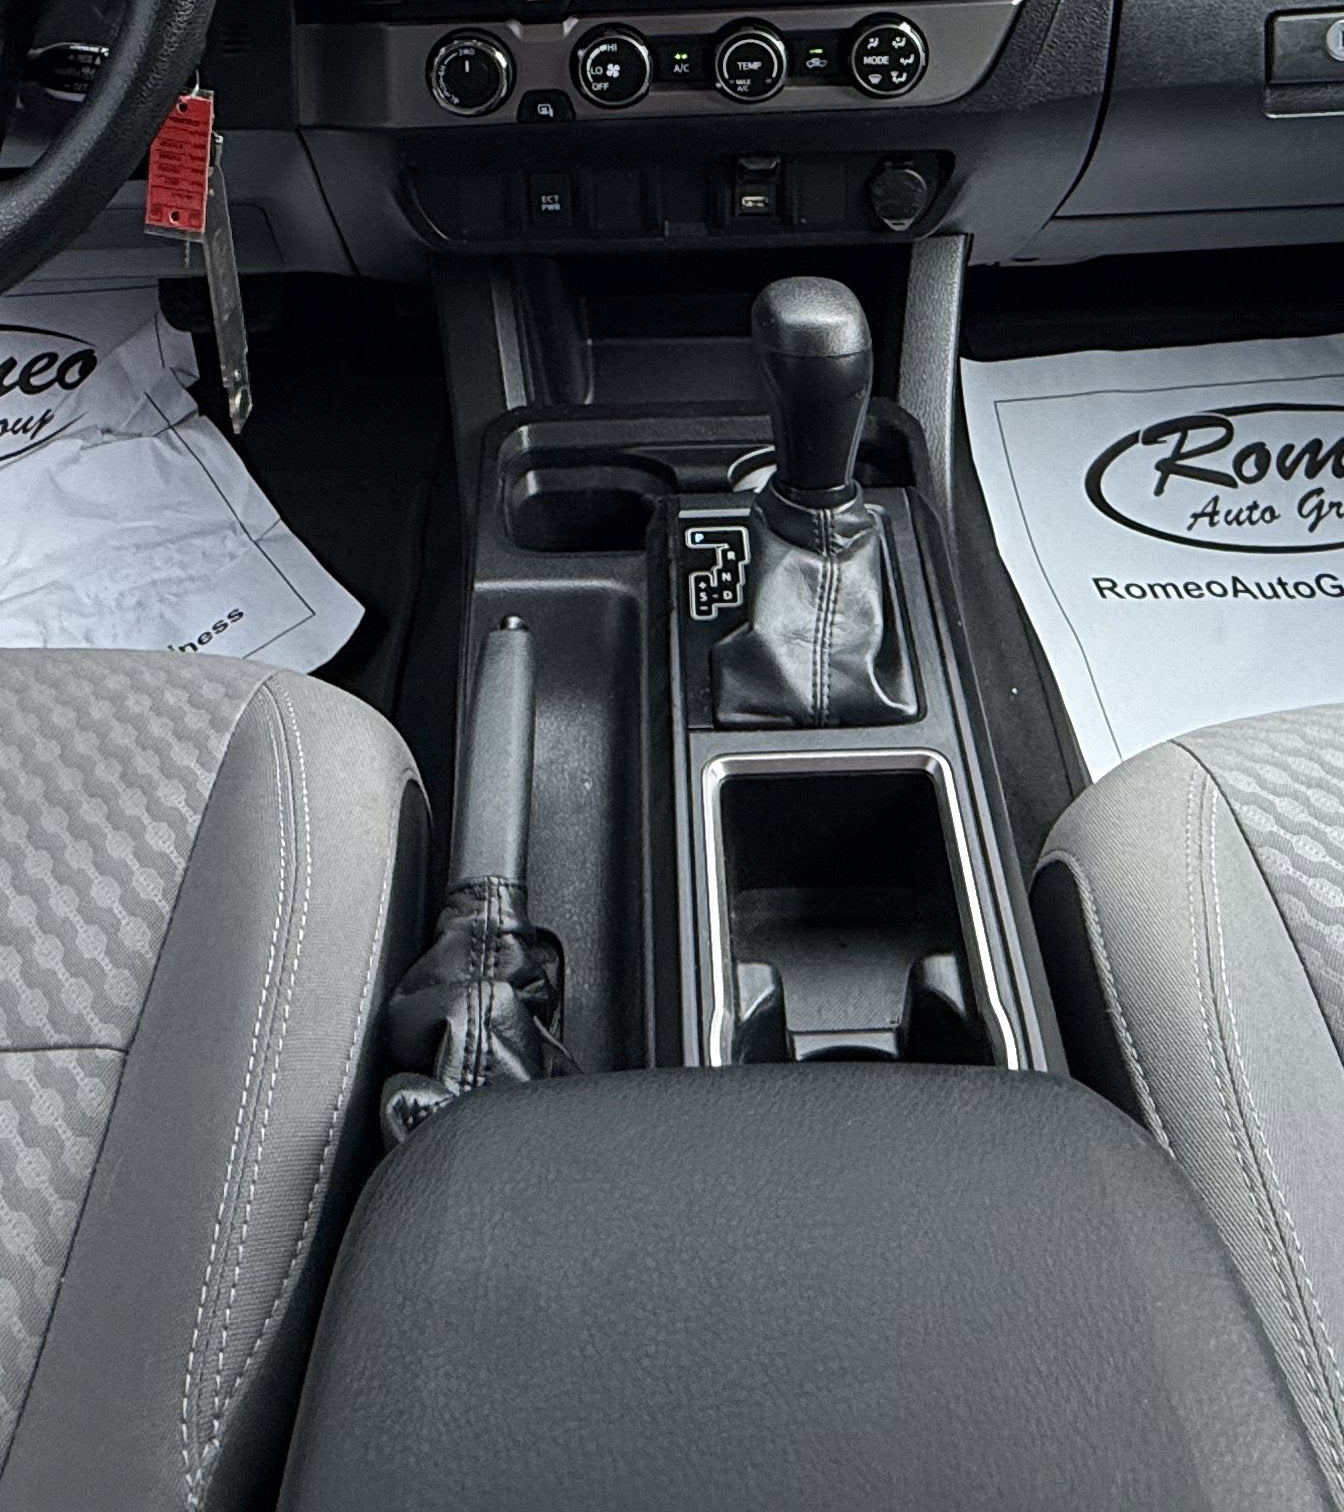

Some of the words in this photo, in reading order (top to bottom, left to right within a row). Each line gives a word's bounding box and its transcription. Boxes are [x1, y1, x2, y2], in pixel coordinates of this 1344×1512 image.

[607, 43, 617, 52] HI
[864, 55, 889, 65] MODE
[673, 64, 690, 73] A/C
[737, 61, 762, 71] TEMP
[591, 67, 603, 76] LO
[592, 82, 609, 91] OFF
[541, 195, 559, 204] ECT
[1186, 495, 1281, 531] Auto
[727, 551, 736, 560] R
[721, 572, 731, 582] N
[699, 591, 708, 601] S
[722, 590, 733, 600] D
